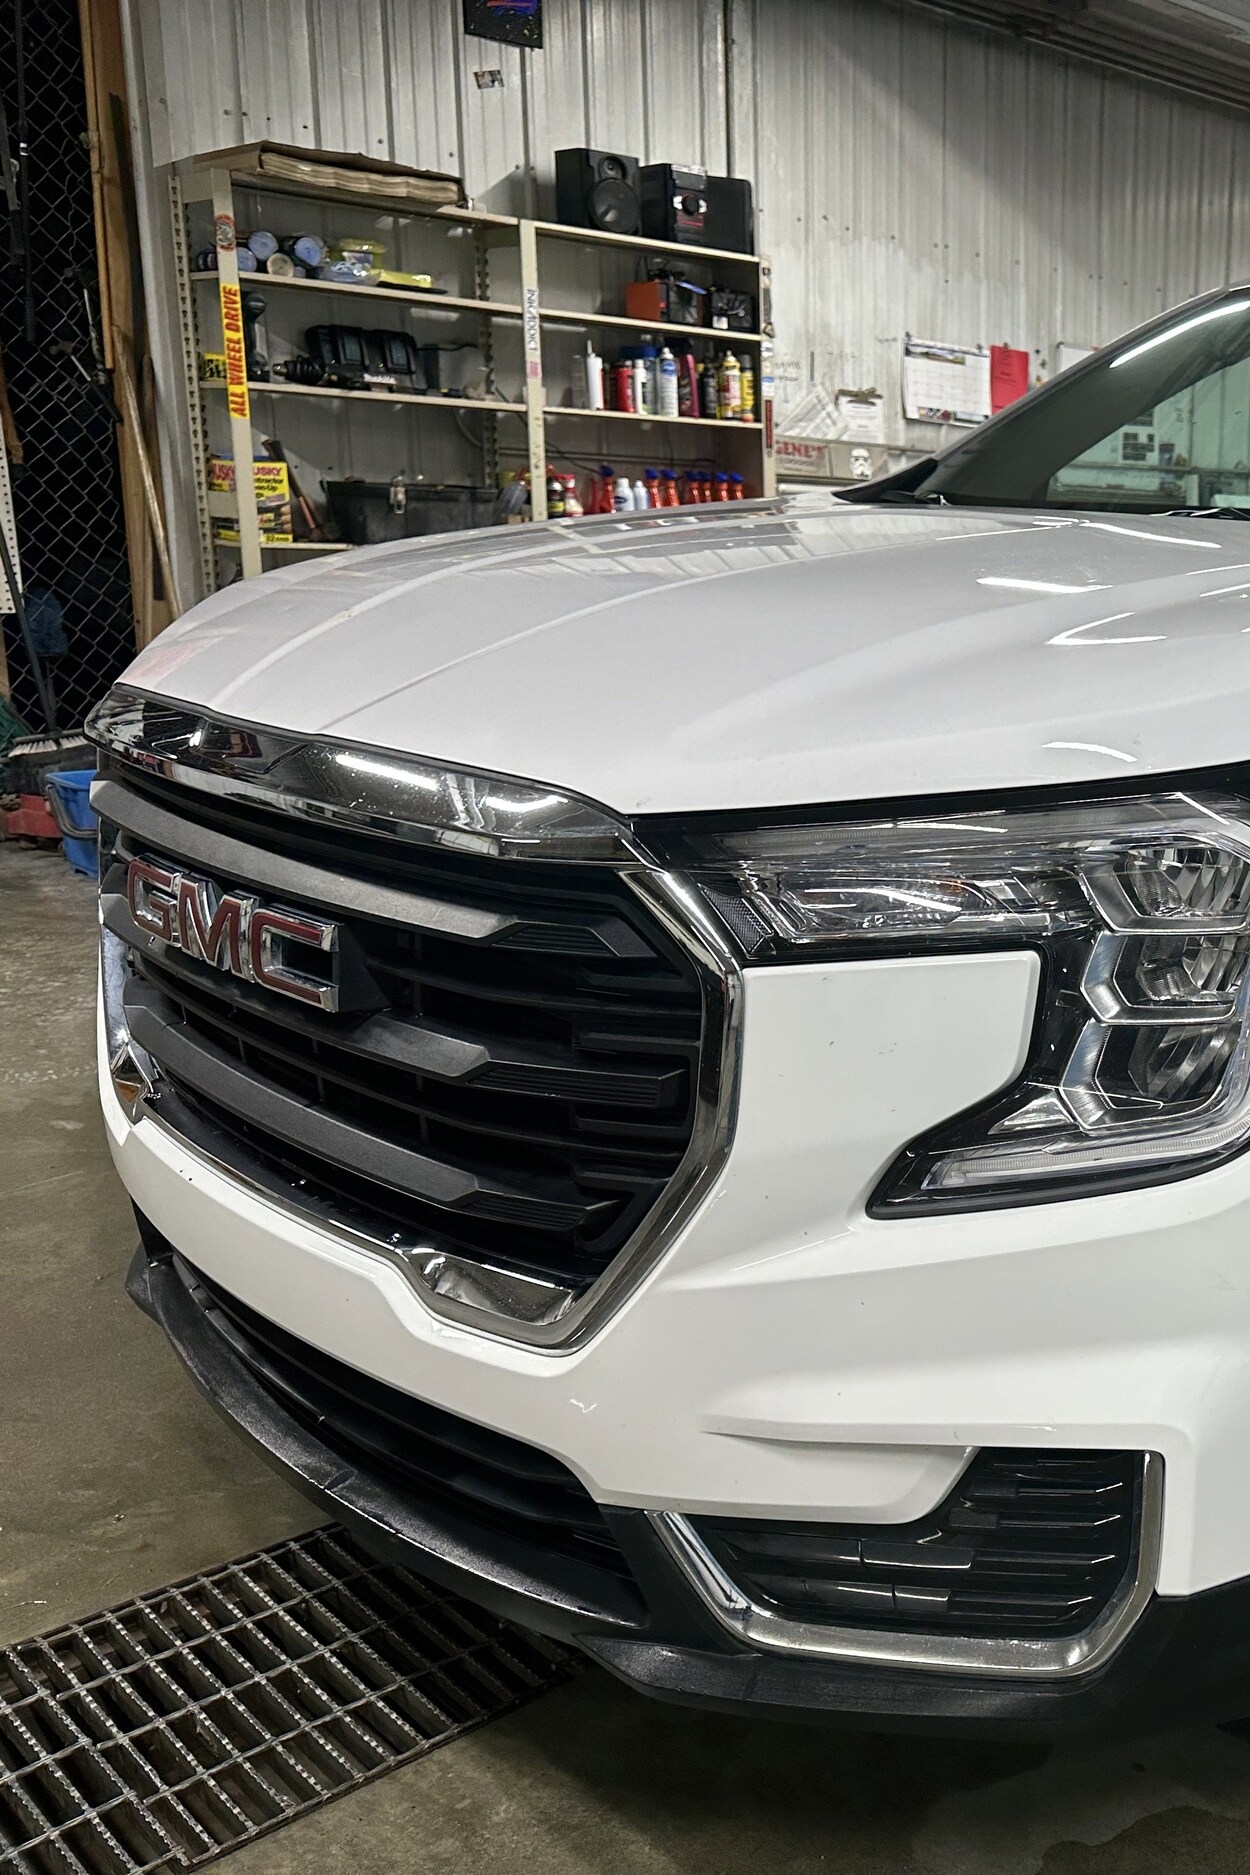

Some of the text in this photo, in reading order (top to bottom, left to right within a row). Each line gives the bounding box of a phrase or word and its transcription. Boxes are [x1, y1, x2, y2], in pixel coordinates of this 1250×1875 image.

[222, 284, 248, 417] ALL WHEEL DRIVE
[127, 854, 340, 1013] GMC
